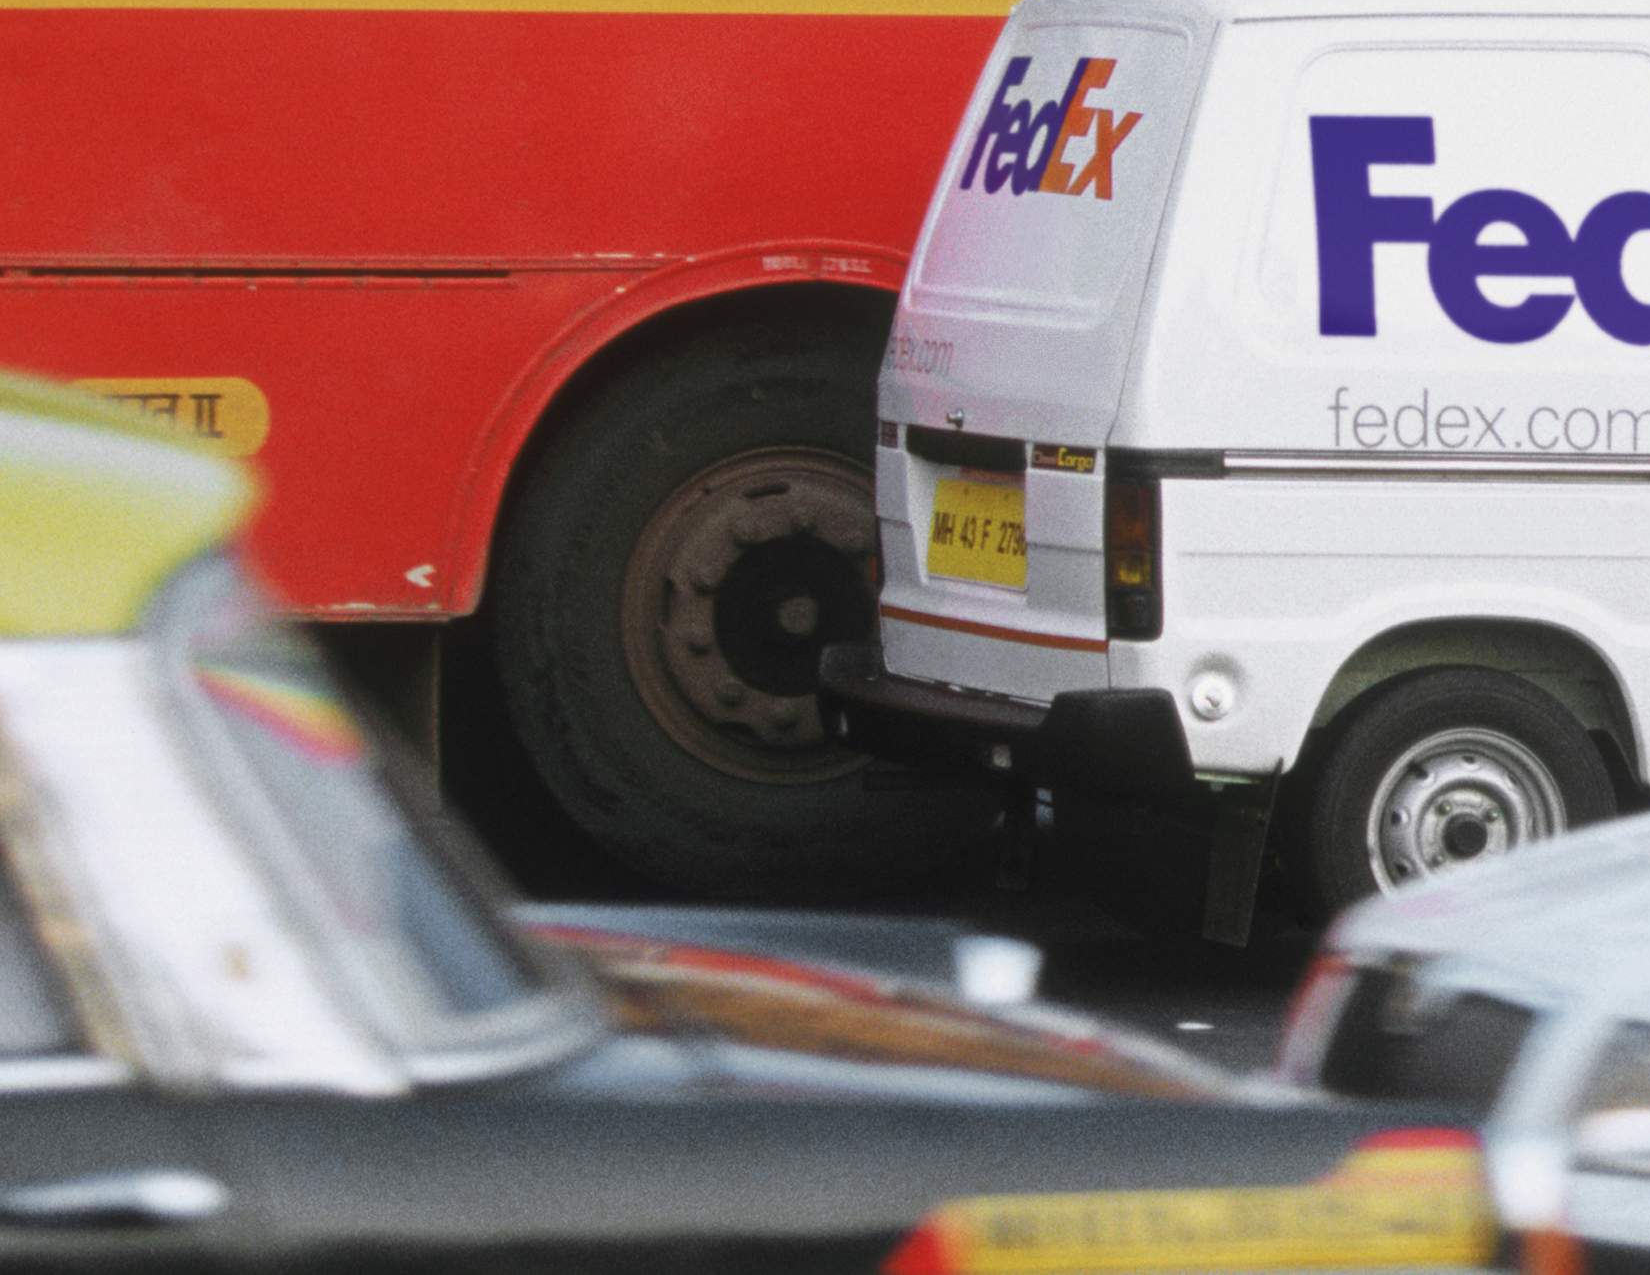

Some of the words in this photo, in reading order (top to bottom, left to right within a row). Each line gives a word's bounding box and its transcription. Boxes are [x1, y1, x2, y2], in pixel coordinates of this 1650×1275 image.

[960, 56, 1145, 201] FedEx
[1058, 447, 1094, 471] Cargo
[932, 511, 956, 546] MH
[960, 515, 977, 550] 43
[980, 518, 993, 551] F
